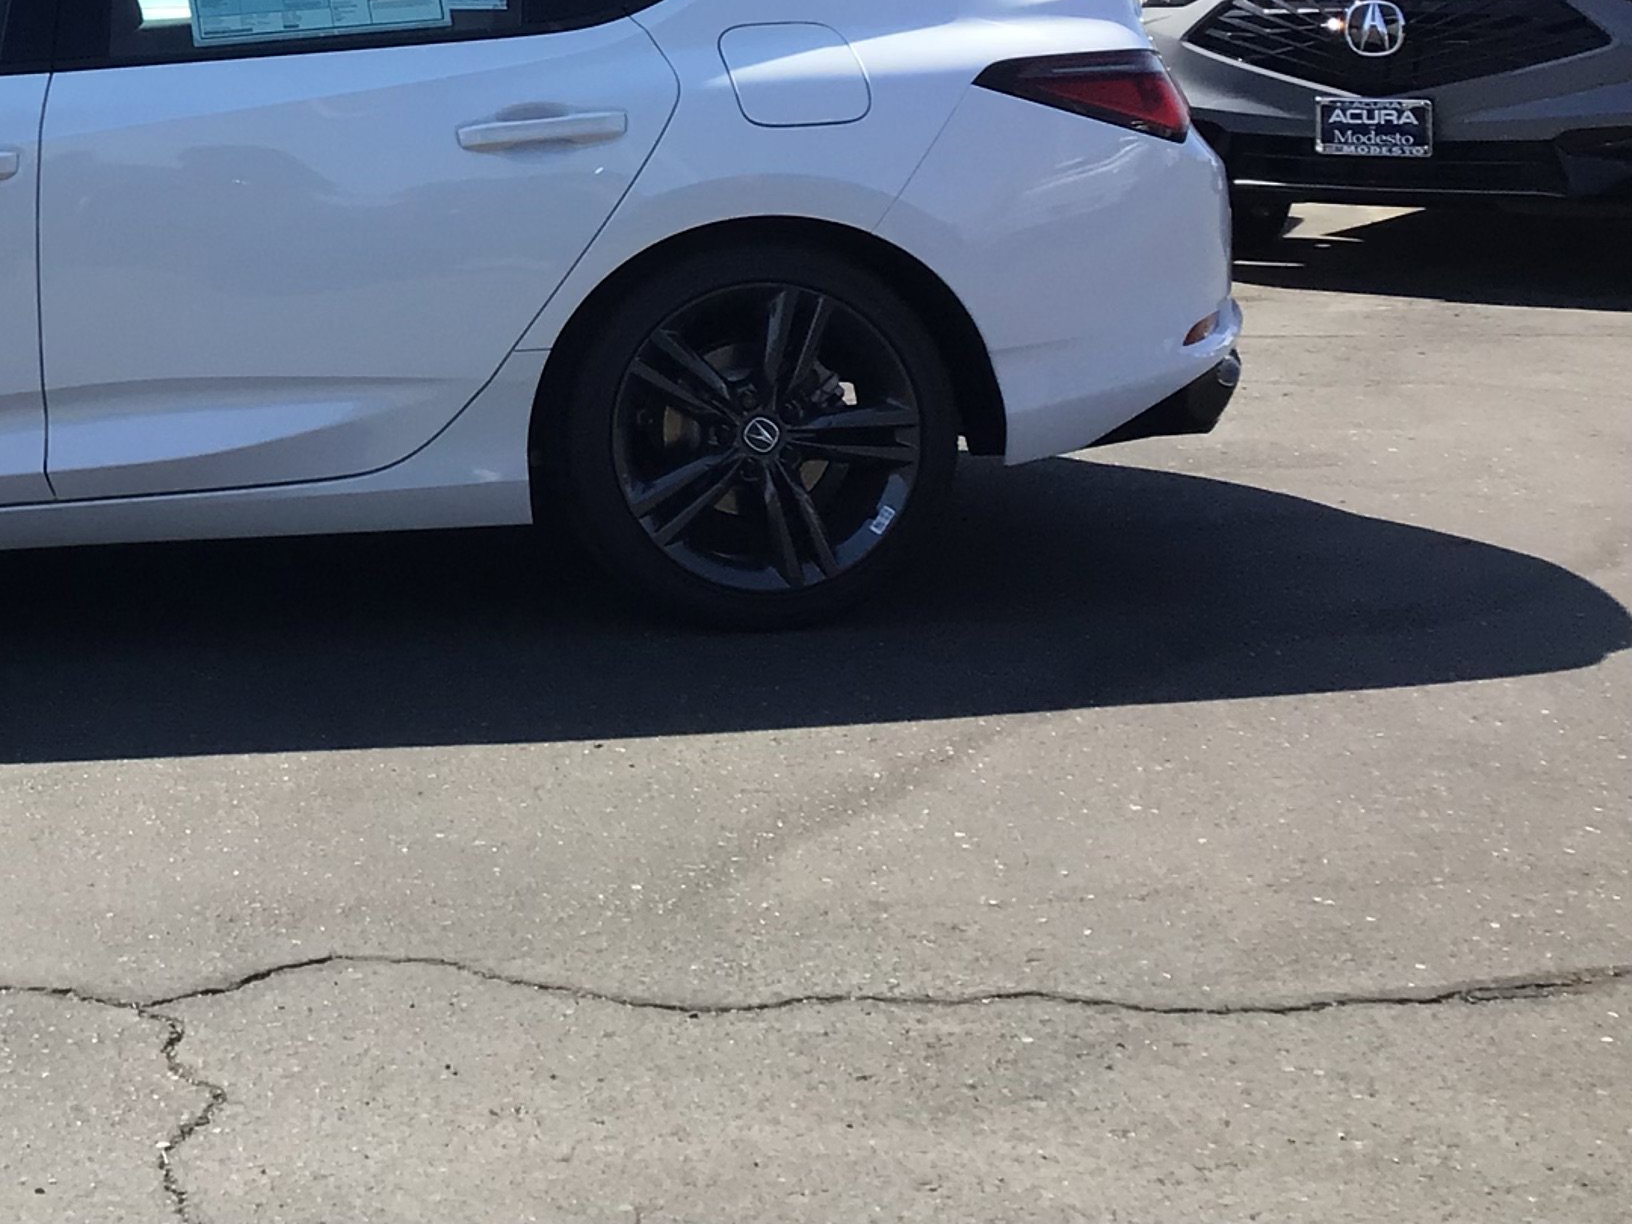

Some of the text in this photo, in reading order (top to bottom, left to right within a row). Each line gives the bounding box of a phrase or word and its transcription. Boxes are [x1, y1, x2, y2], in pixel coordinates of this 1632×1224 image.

[1328, 108, 1419, 125] ACURA
[1333, 129, 1415, 145] Modesto
[1342, 145, 1425, 156] MODESTO
